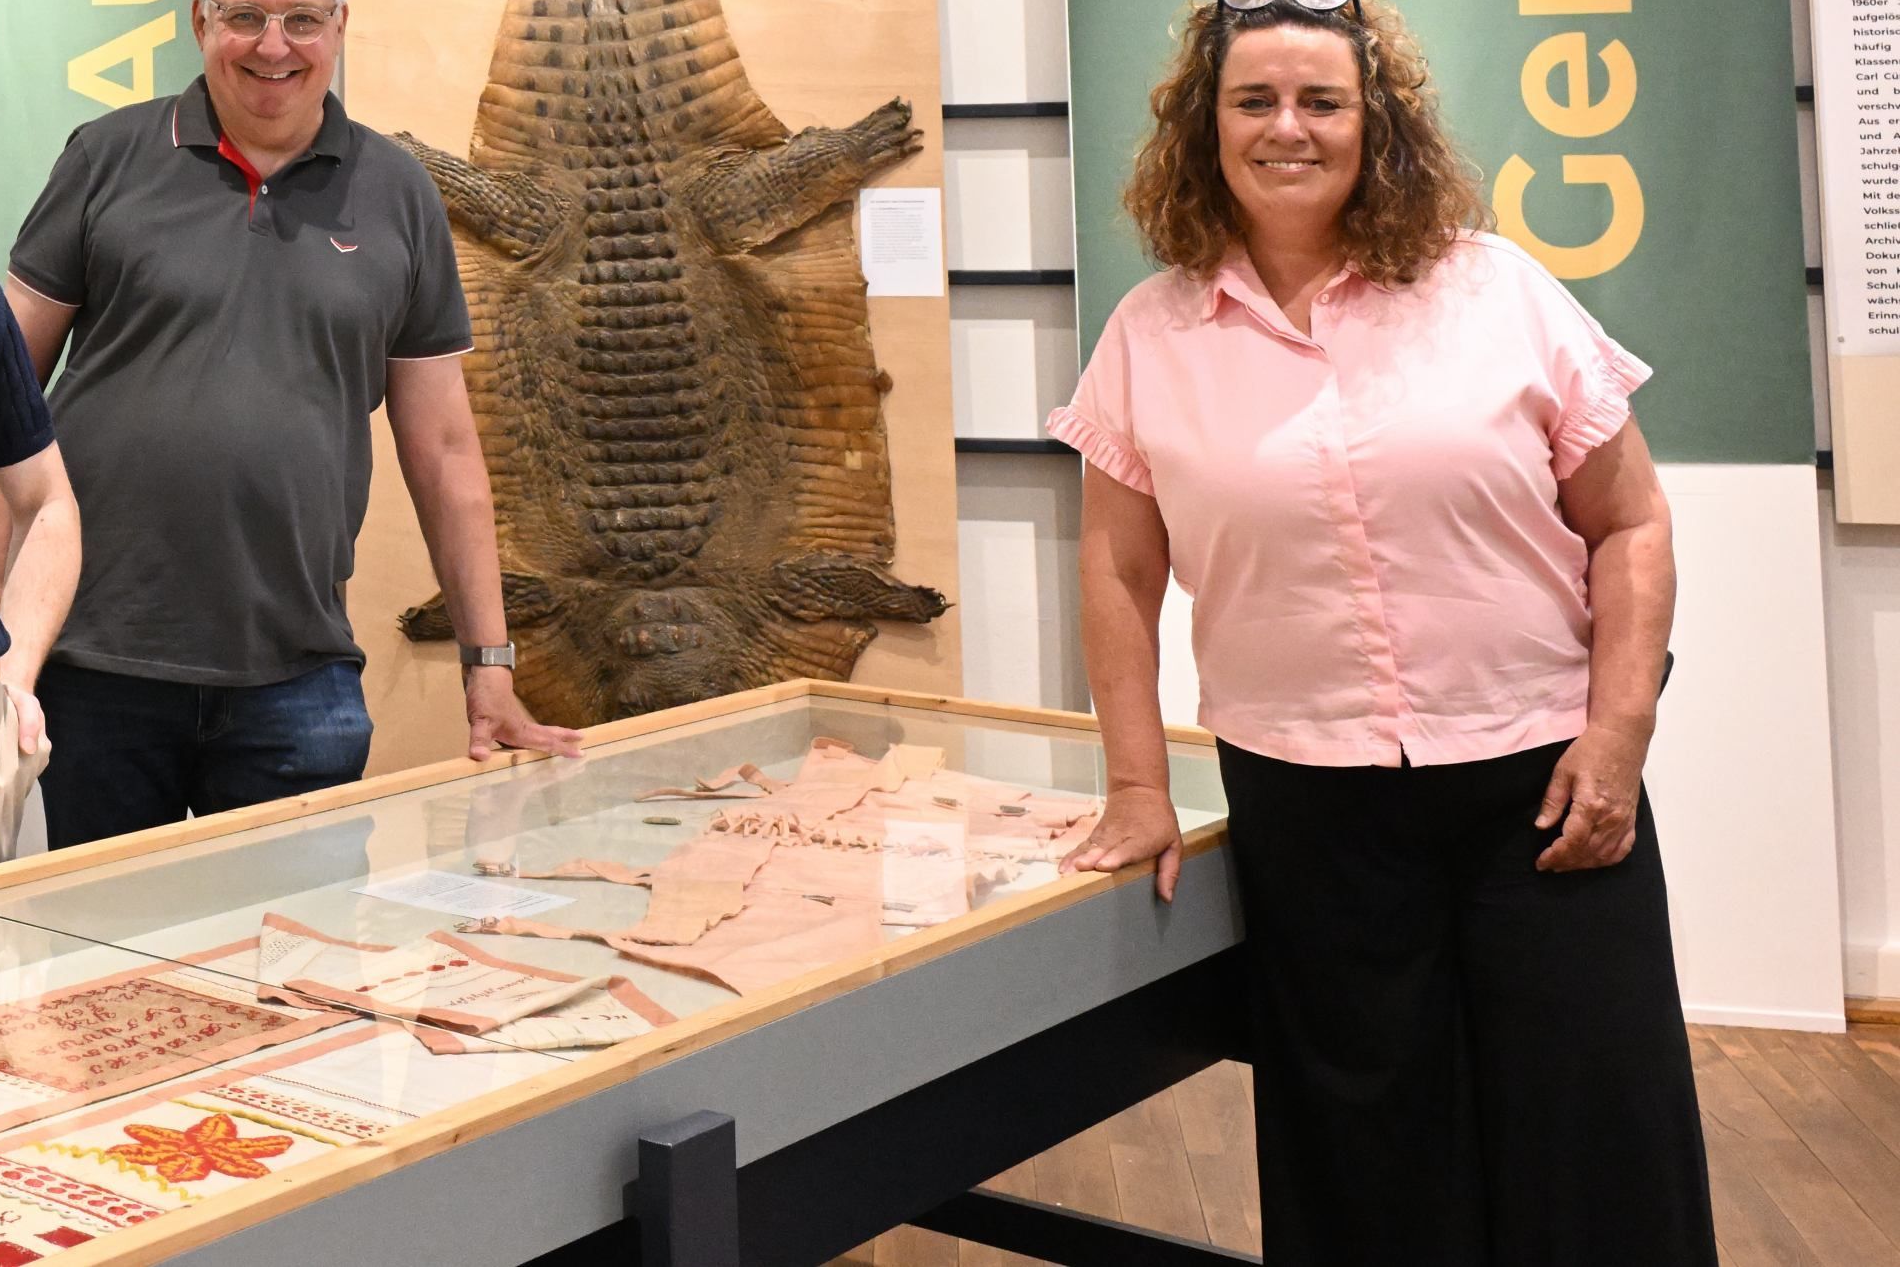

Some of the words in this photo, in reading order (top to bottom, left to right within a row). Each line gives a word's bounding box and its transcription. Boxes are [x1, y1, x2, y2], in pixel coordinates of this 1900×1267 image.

[1853, 42, 1892, 53] häufig
[1855, 72, 1879, 81] Carl
[1856, 87, 1880, 96] und
[1858, 117, 1880, 126] Aus
[1859, 131, 1882, 141] und
[1861, 176, 1899, 185] wurde
[1862, 191, 1882, 200] Mit
